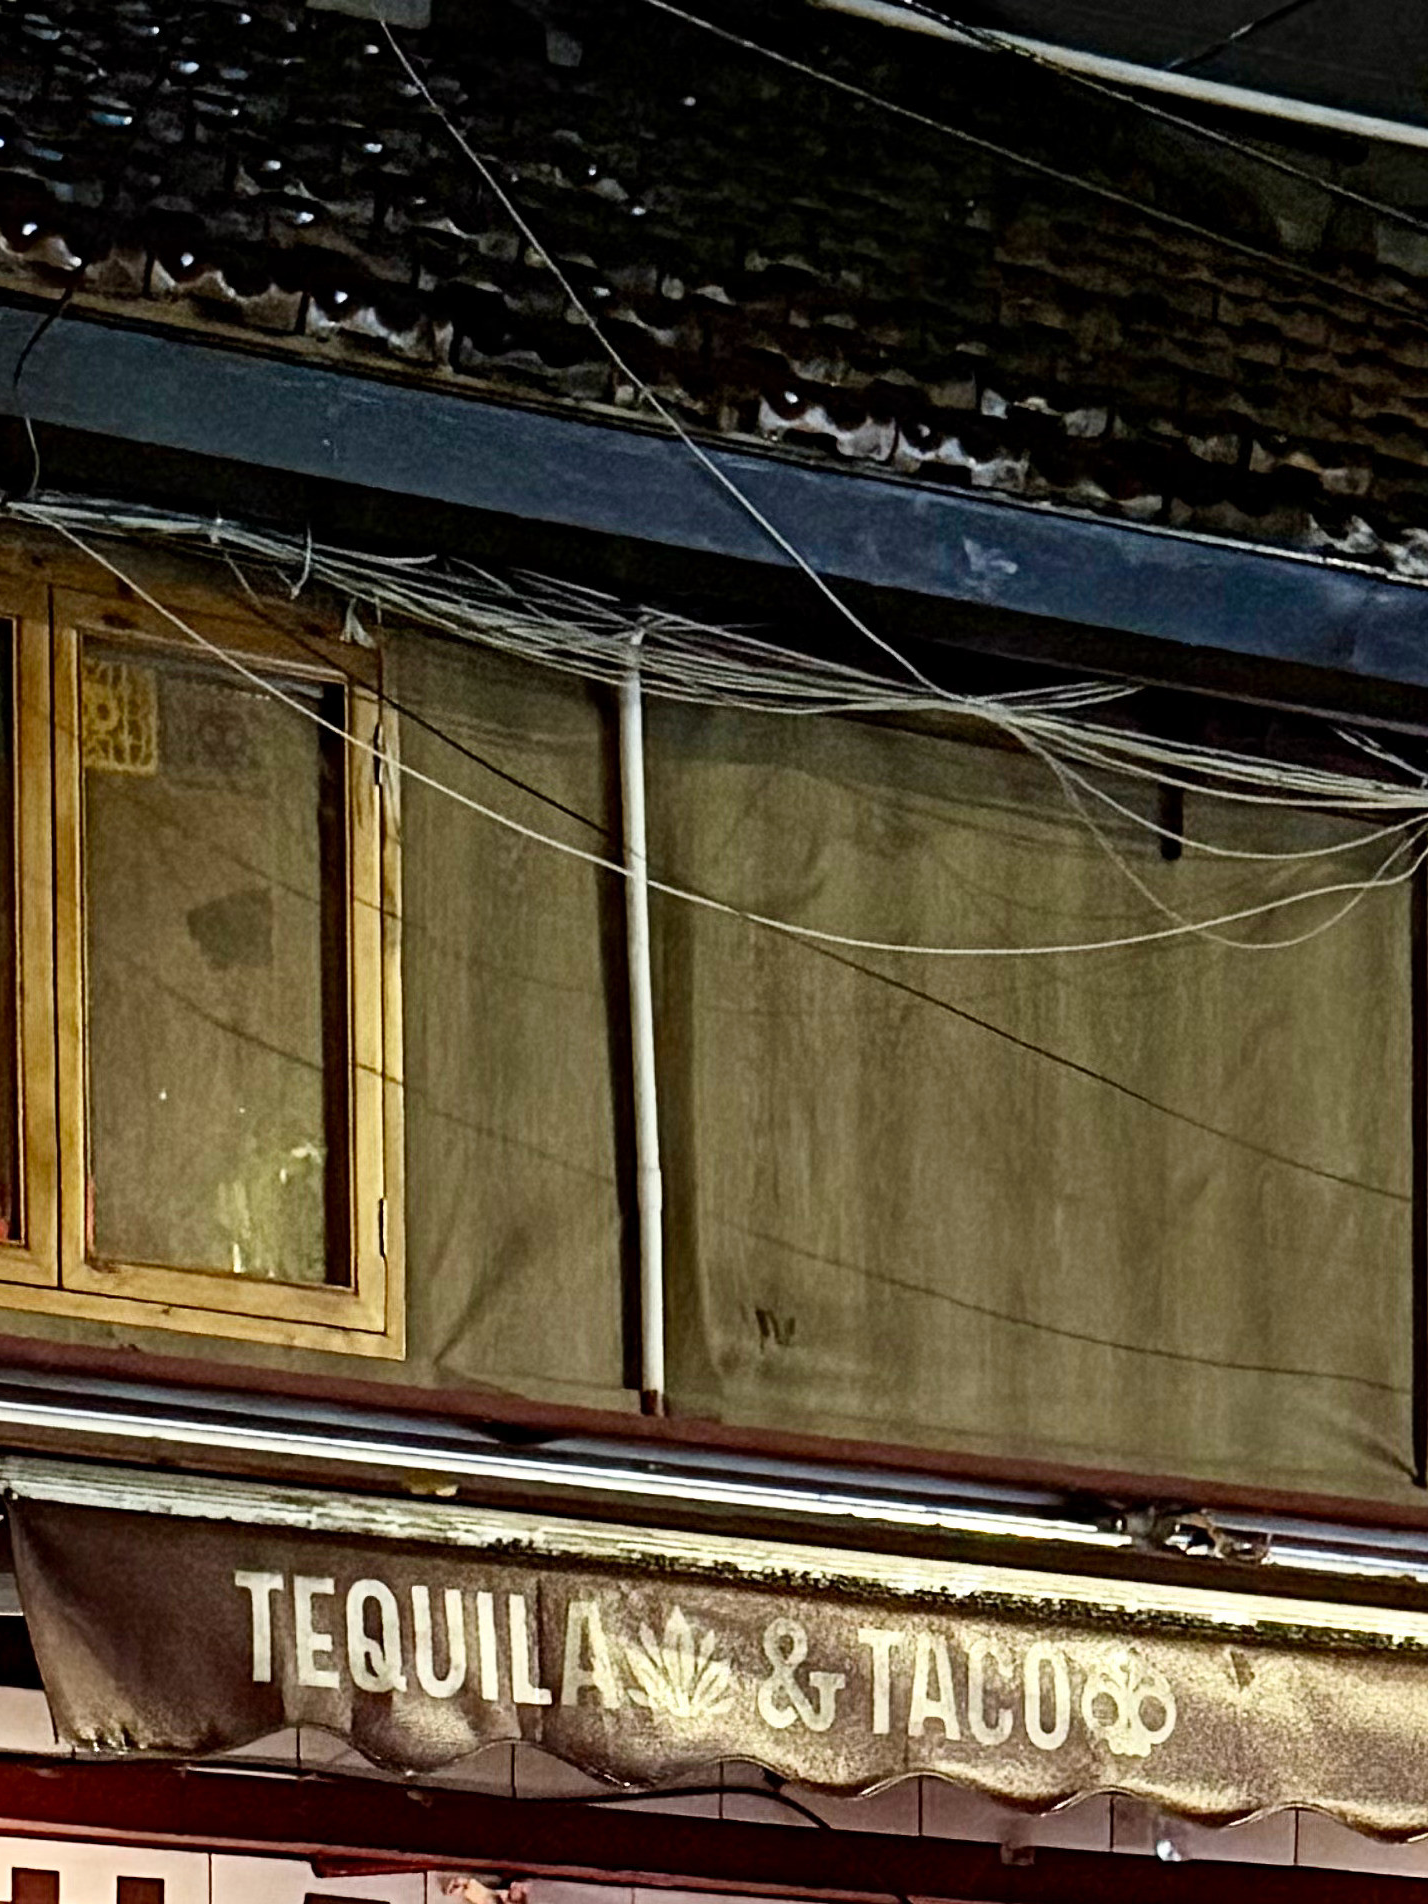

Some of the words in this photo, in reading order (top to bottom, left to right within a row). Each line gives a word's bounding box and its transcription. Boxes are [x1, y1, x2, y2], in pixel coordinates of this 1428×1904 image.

[234, 1570, 624, 1710] TEQUILA
[758, 1616, 846, 1732] &
[858, 1628, 1070, 1751] TACO
